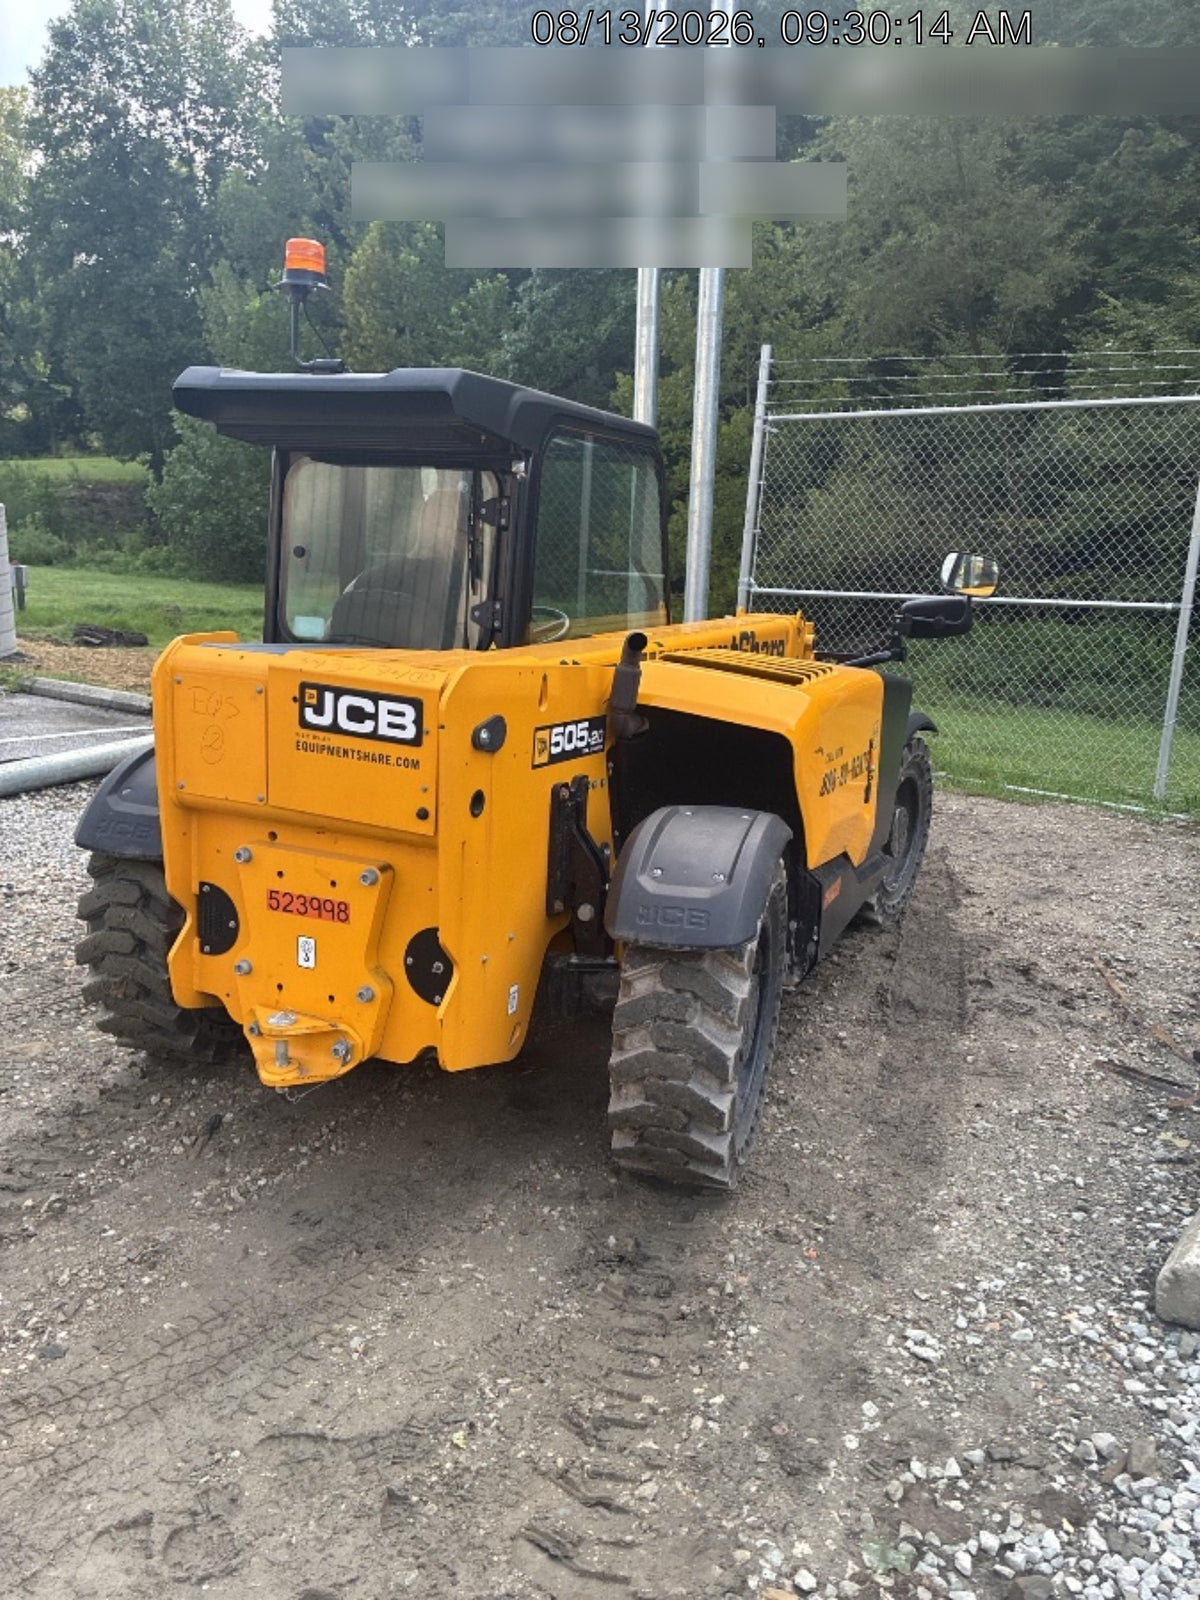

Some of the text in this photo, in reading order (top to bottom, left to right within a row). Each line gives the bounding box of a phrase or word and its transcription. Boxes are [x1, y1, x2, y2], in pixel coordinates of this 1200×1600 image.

[304, 690, 417, 740] JCB
[295, 739, 421, 771] EQUIPMENTSHARE.COM
[267, 889, 350, 924] 523998
[636, 903, 712, 931] JCB
